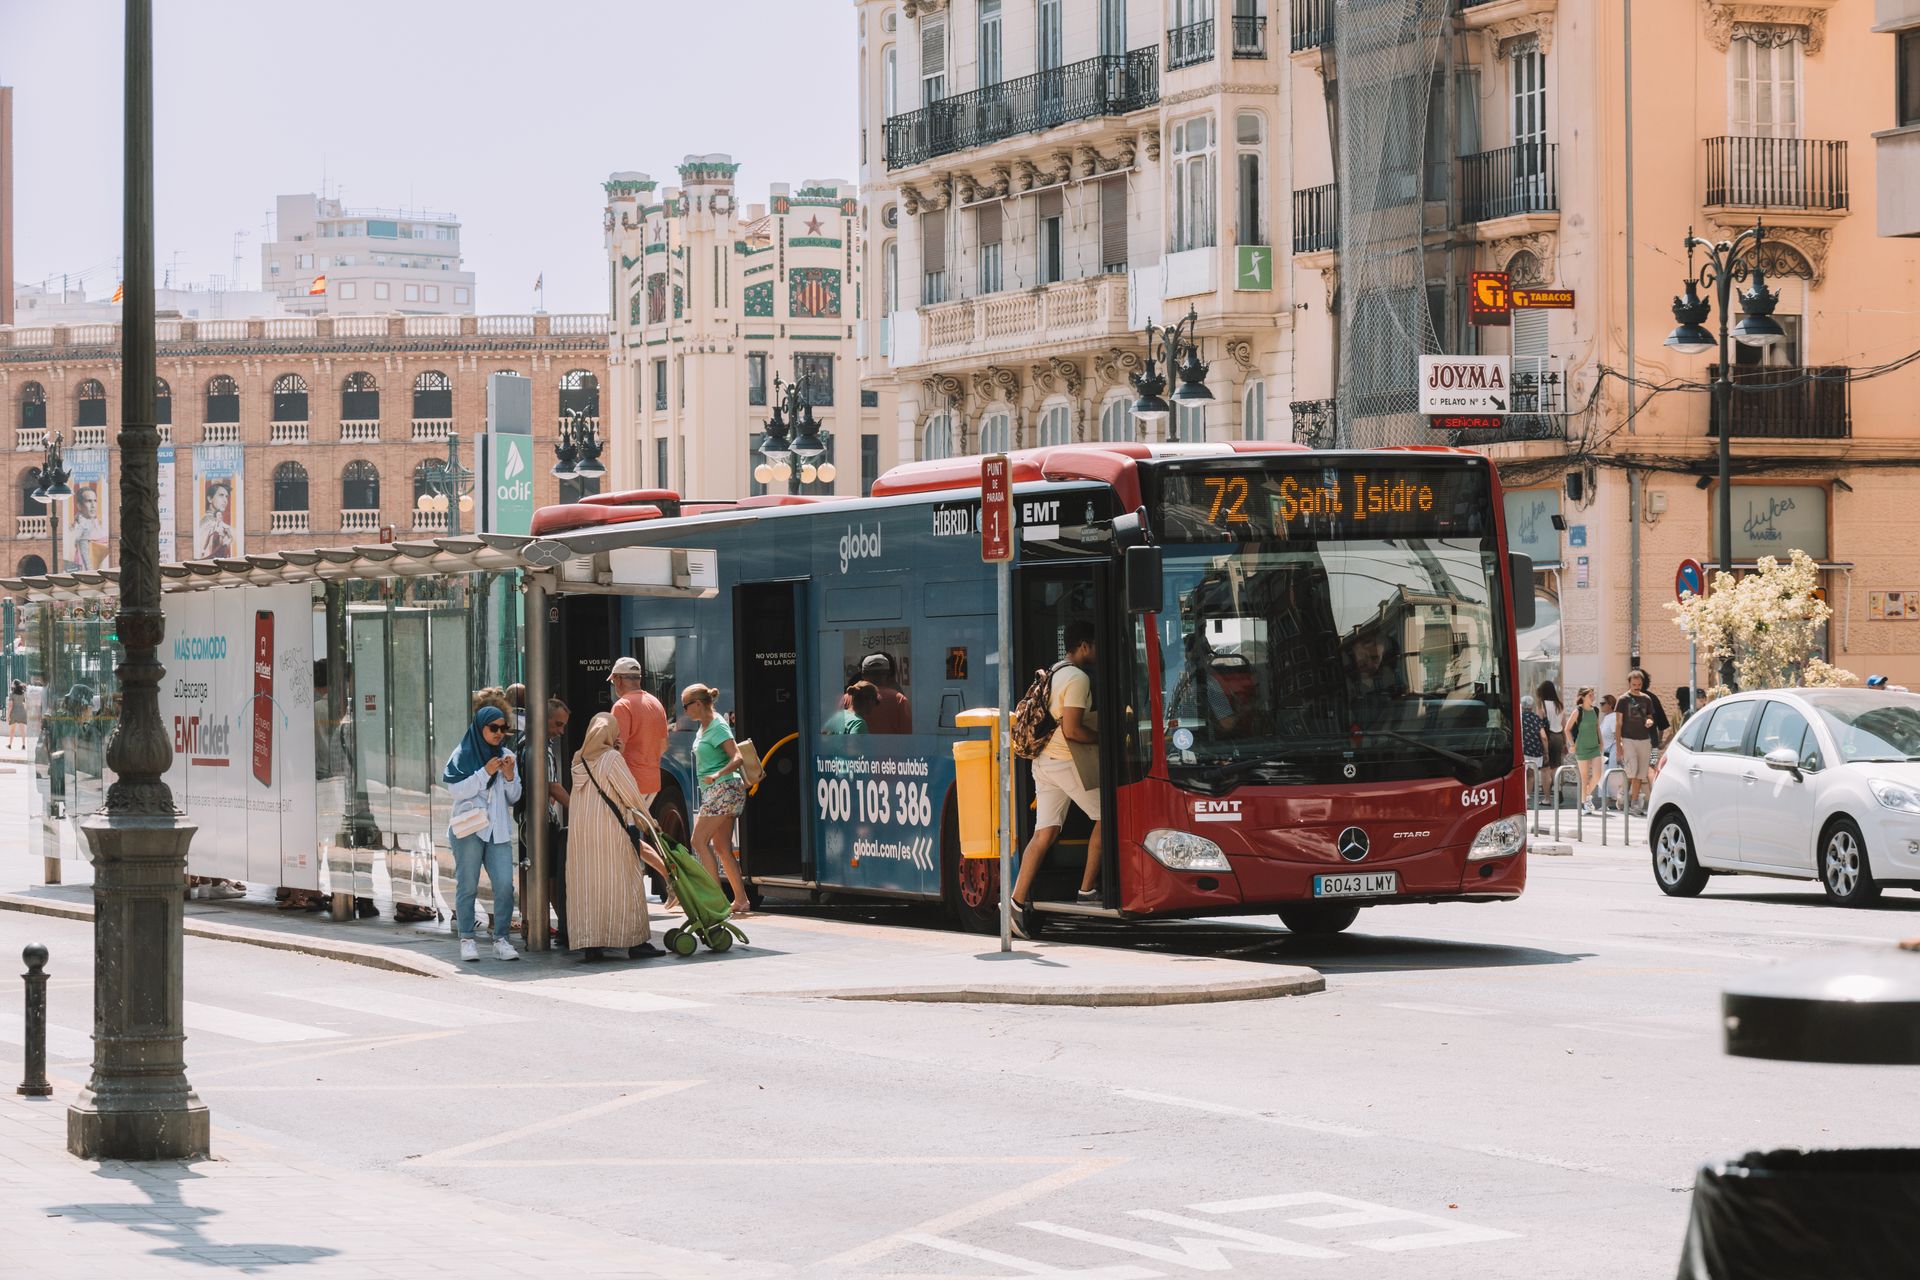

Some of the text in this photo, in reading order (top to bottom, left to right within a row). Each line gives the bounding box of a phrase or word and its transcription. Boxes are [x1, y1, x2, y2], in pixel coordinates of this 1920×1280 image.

[1530, 293, 1572, 302] TABACOS
[1429, 364, 1505, 390] JOYMA
[1433, 418, 1441, 426] Y
[1445, 416, 1489, 427] SEÑORA
[987, 462, 1003, 476] PUNT
[497, 480, 532, 500] adif
[992, 479, 998, 490] DE
[986, 492, 1004, 503] PARADA
[1203, 474, 1433, 523] 72 Sant Isidre
[933, 503, 968, 536] HÍBRID
[1023, 500, 1060, 523] EMT
[838, 521, 882, 574] global
[174, 632, 190, 660] MÁS
[179, 679, 208, 703] Descarga
[365, 694, 376, 704] EMT
[174, 708, 230, 755] EMTicket
[817, 756, 928, 776] tu mejor versión en este autobús
[817, 778, 932, 827] 900 103 386
[1194, 800, 1242, 812] EMT
[1461, 788, 1497, 807] 6491
[854, 838, 911, 861] global.com/es
[1324, 877, 1361, 893] 6043
[1366, 875, 1393, 891] LMY
